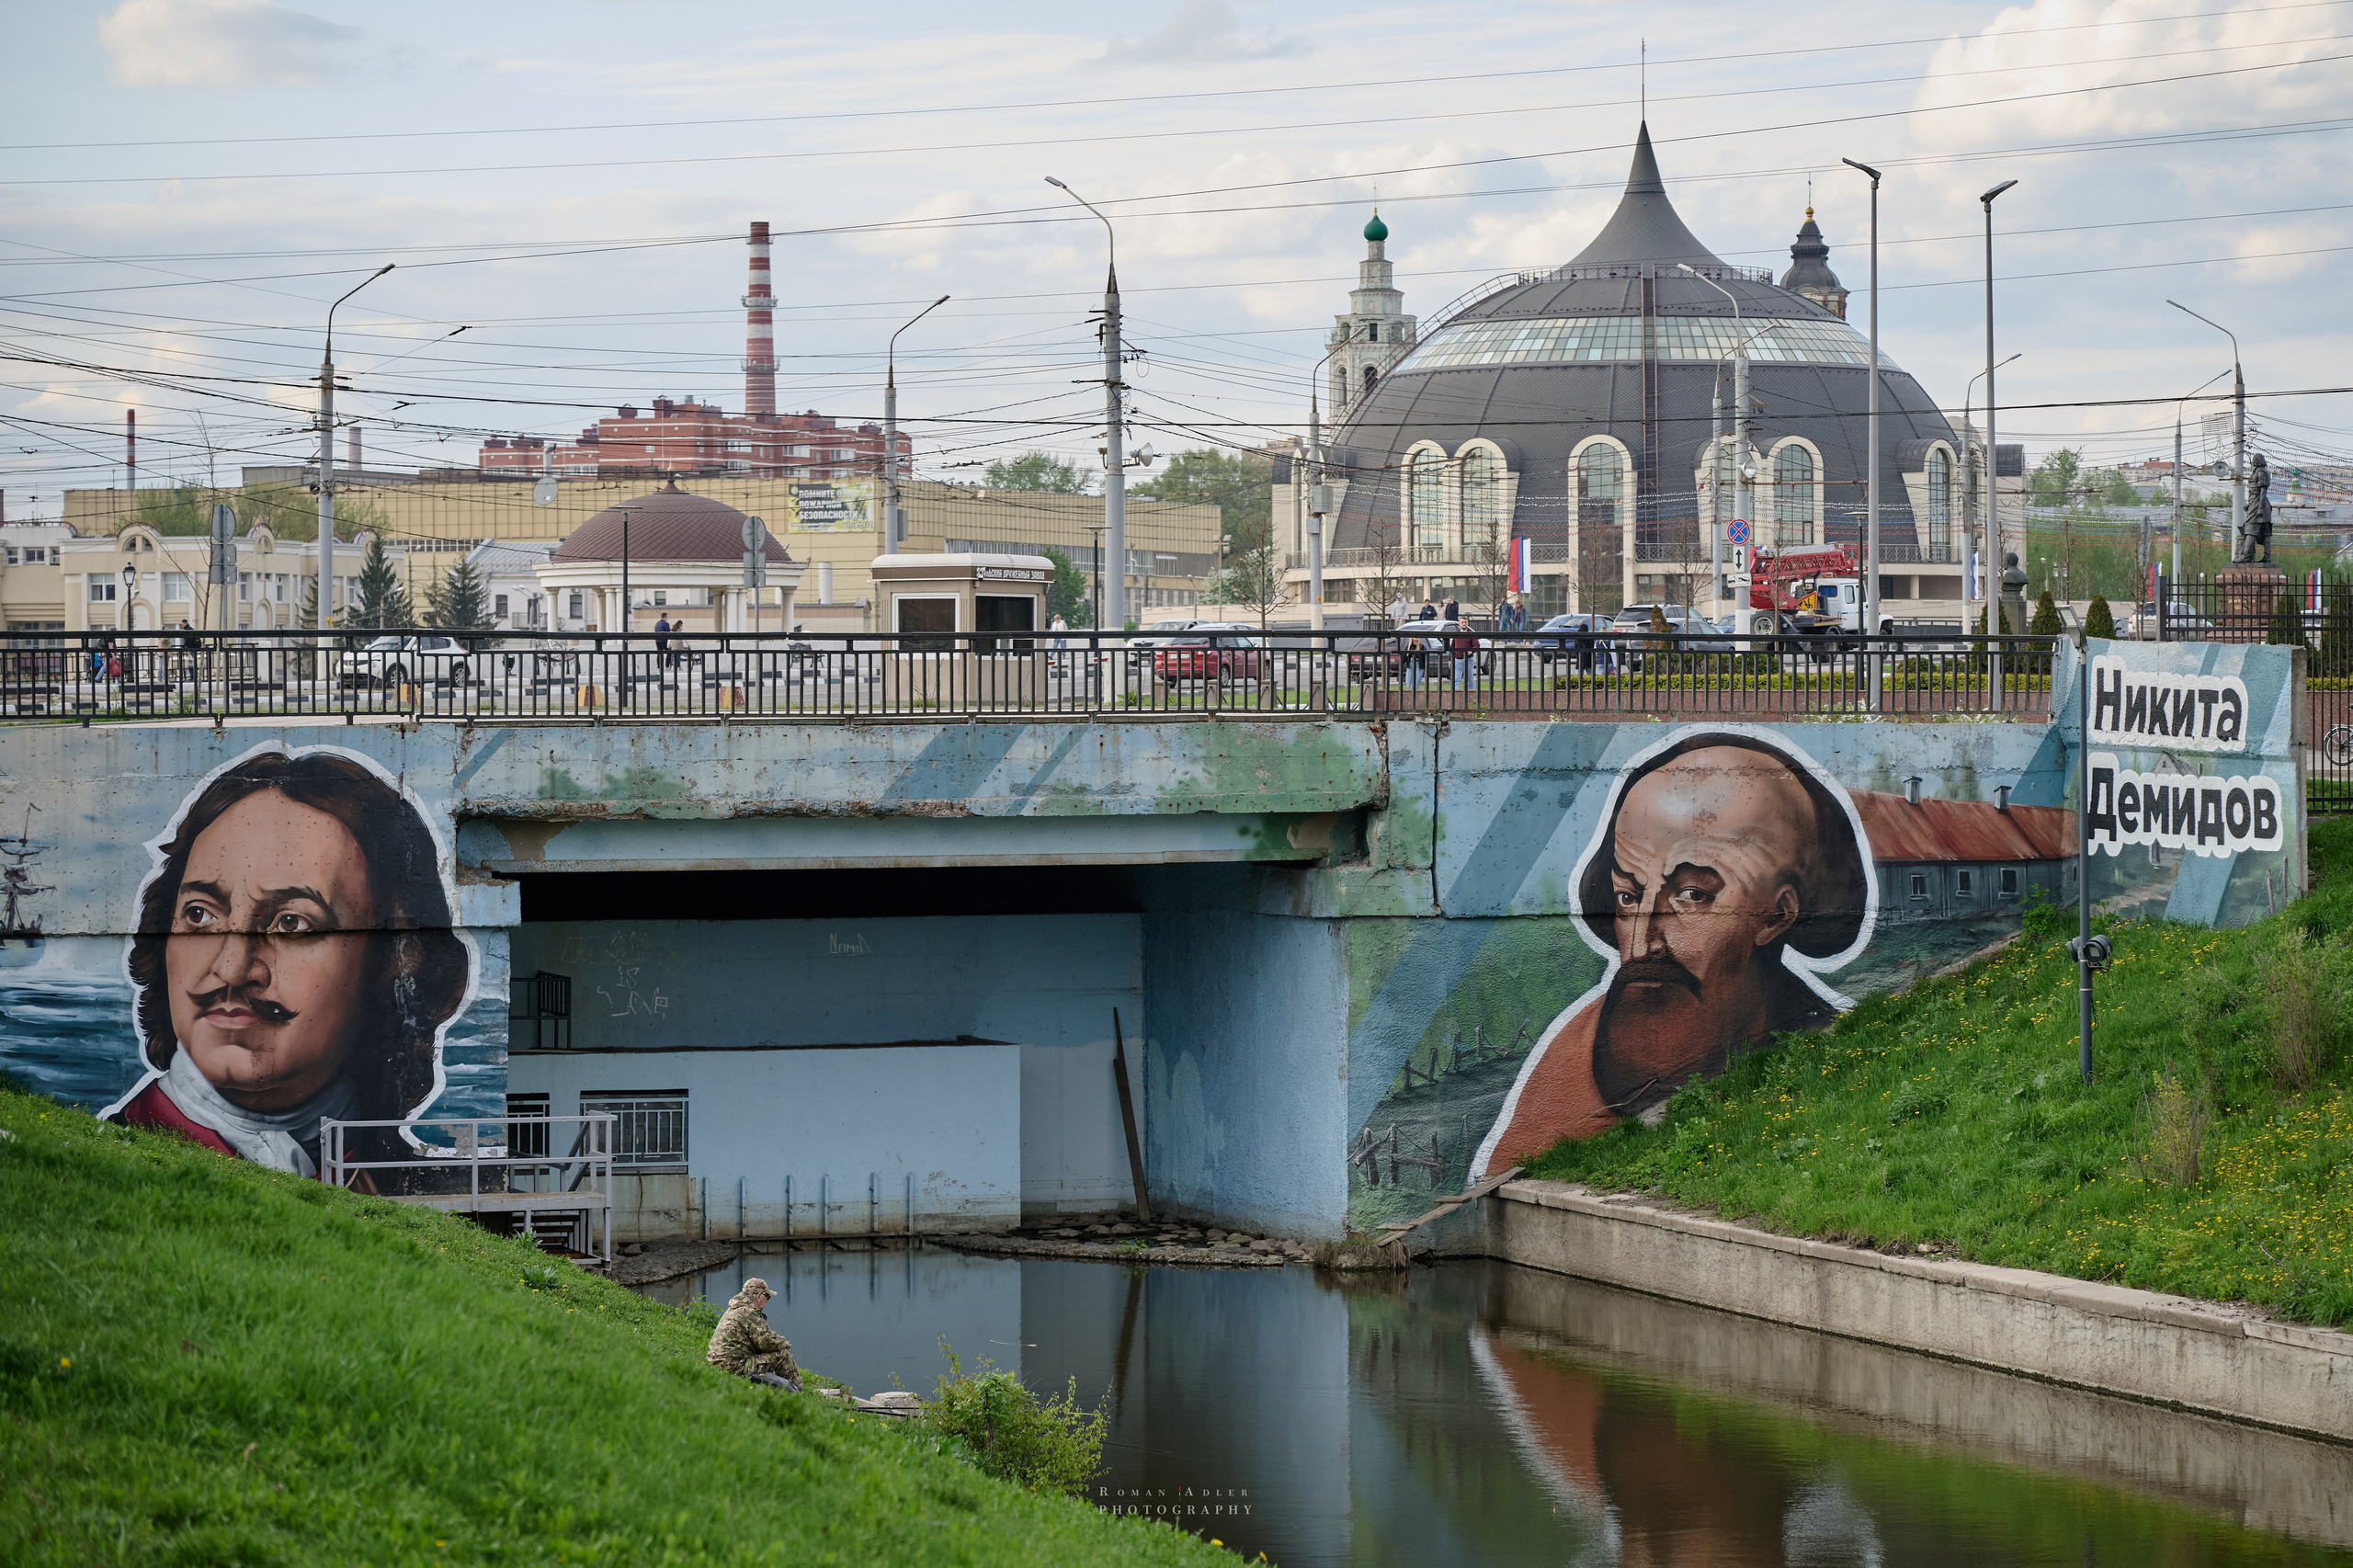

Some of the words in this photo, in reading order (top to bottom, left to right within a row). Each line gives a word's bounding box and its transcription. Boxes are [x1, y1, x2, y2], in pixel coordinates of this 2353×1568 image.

[799, 489, 835, 498] ПОМНИТЕ
[836, 490, 843, 498] О
[799, 500, 842, 509] ПОЖАРНОЙ
[799, 510, 858, 520] БЕЗОПАСНОСТИ
[2094, 667, 2243, 742] Никита
[2087, 767, 2278, 846] Демидов
